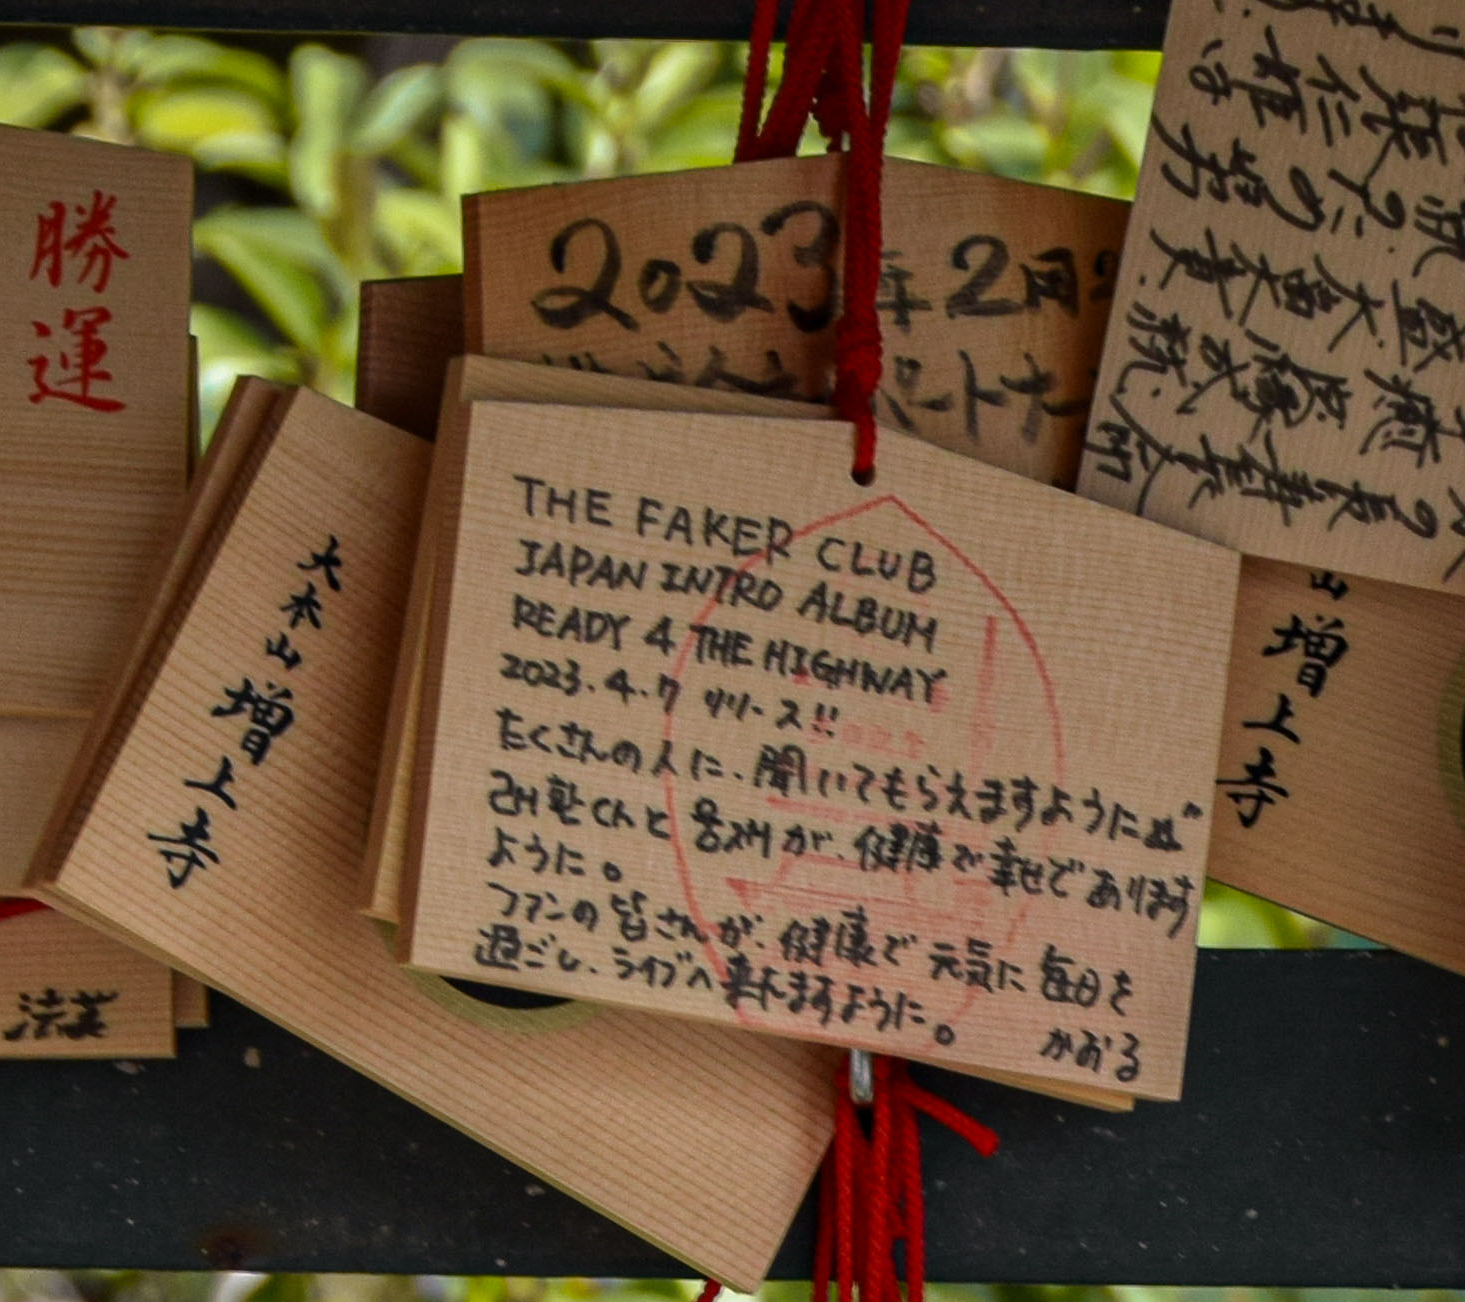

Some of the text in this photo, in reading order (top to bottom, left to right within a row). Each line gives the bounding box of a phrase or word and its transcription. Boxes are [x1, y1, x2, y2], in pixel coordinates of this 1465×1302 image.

[26, 191, 130, 414] 勝運
[513, 474, 936, 594] THE FAKER CLUB
[513, 593, 947, 703] READY 4 THE HIGHWAY
[515, 539, 939, 653] JAPAN INTRO ALBUM
[147, 535, 344, 889] 大本山増上寺
